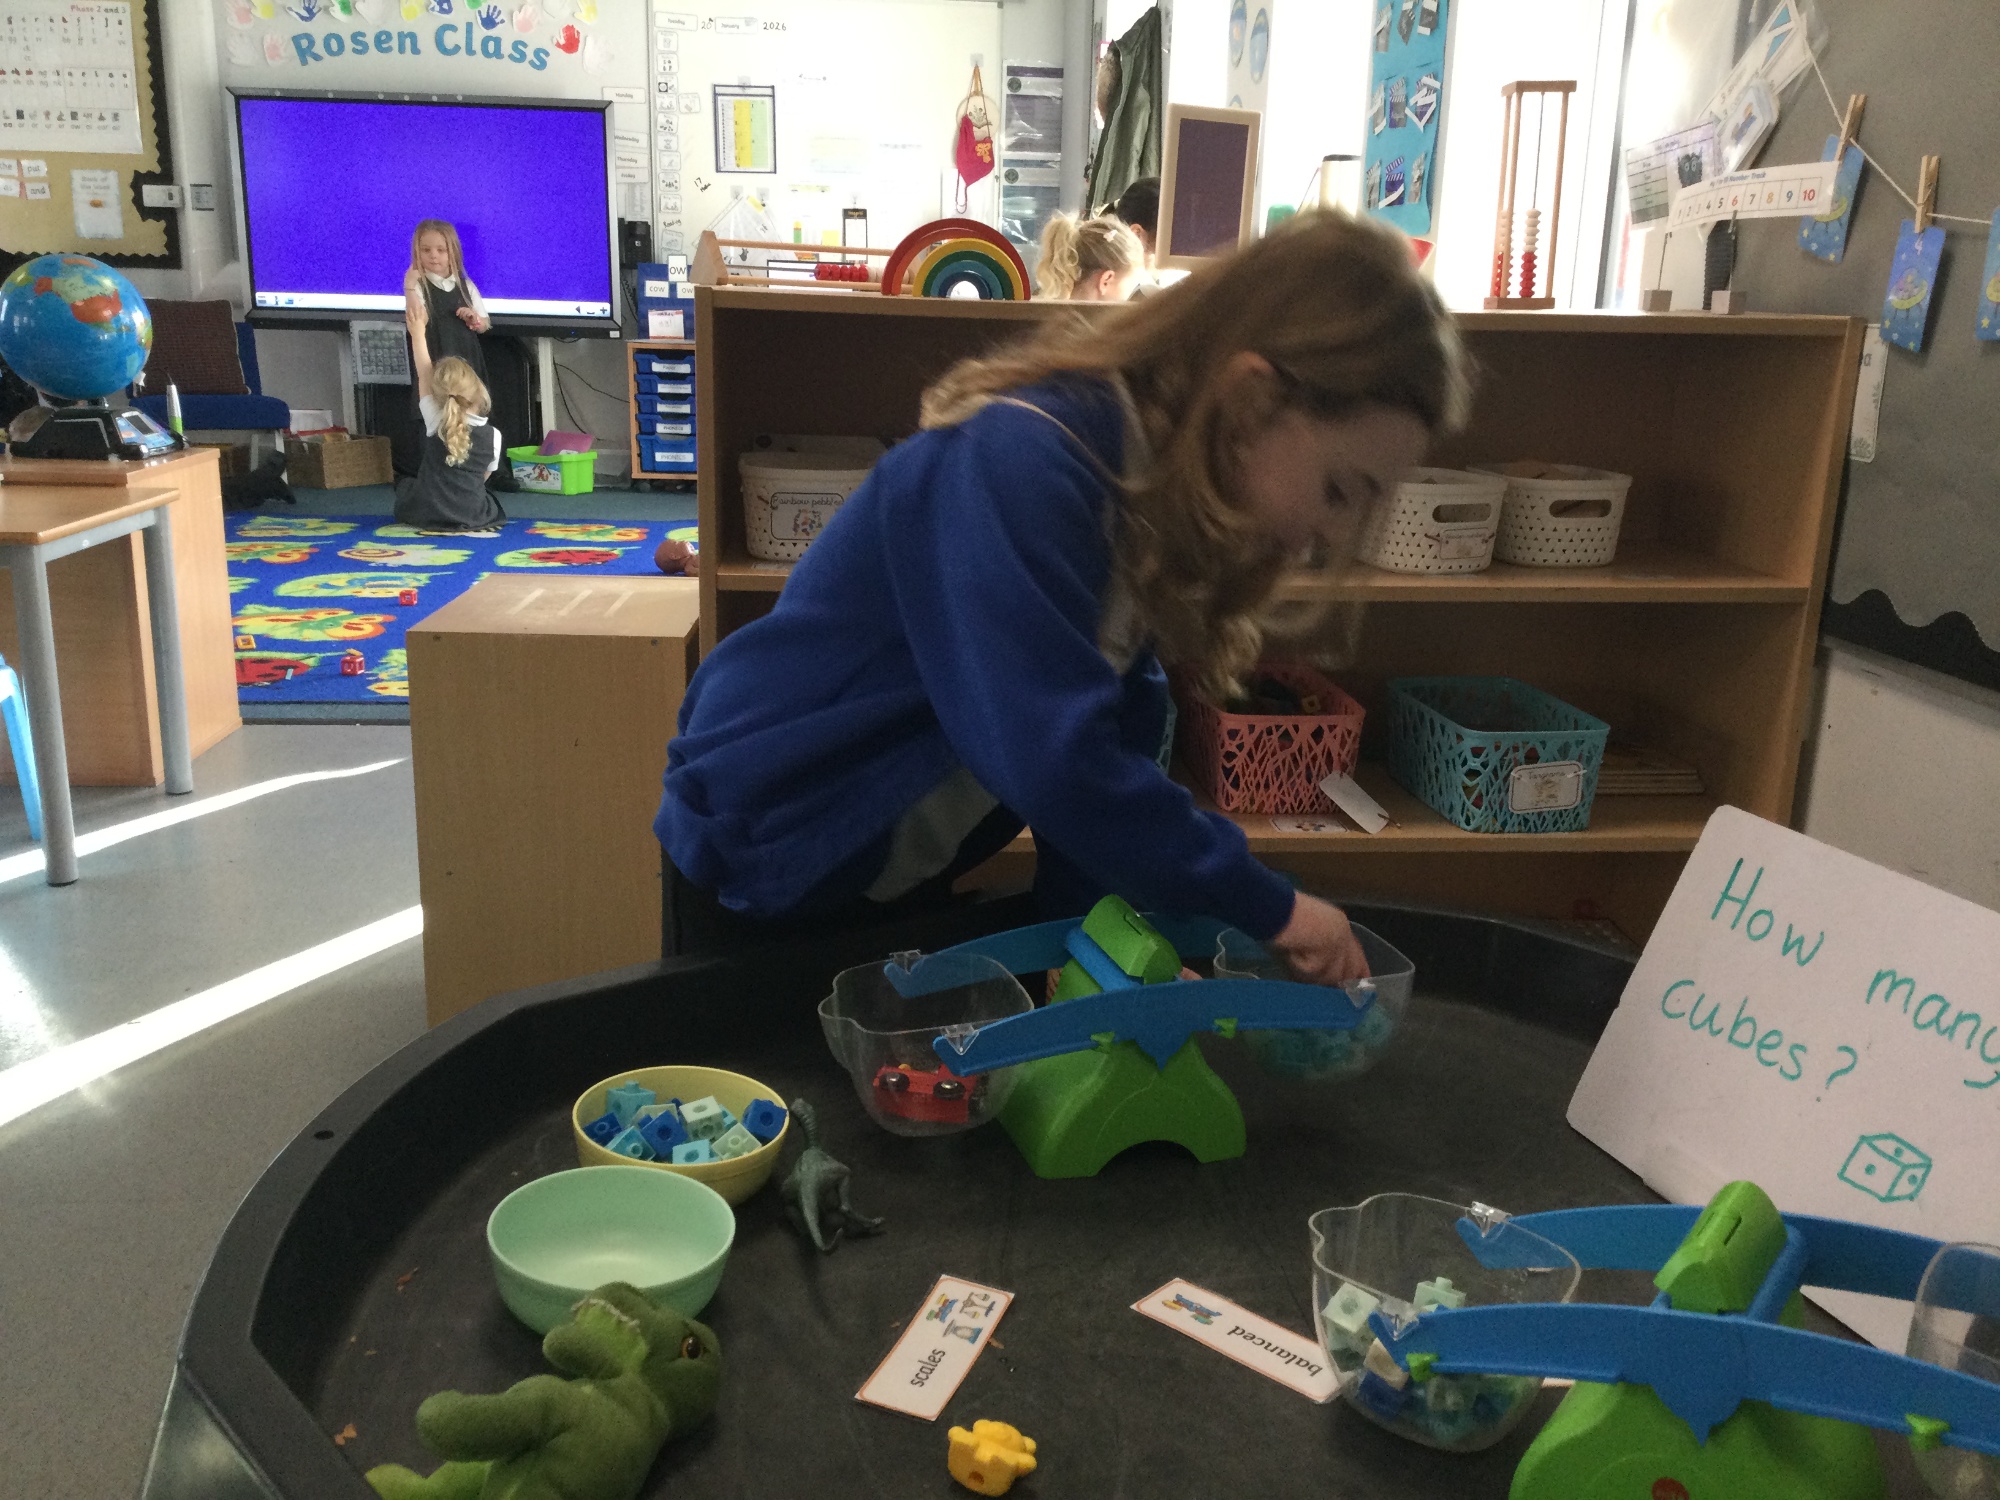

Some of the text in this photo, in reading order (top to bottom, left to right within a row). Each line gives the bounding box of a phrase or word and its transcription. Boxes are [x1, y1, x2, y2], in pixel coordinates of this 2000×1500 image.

[762, 21, 787, 31] 2026
[291, 21, 551, 71] Rosen Class
[615, 91, 634, 99] Monday
[30, 186, 46, 195] and
[1705, 200, 1711, 210] 4
[1717, 197, 1724, 208] 5
[1731, 193, 1738, 206] 6
[1749, 193, 1756, 205] 7
[1766, 191, 1774, 204] 8
[1786, 190, 1793, 202] 9
[1802, 188, 1816, 202] 10
[1710, 857, 2000, 1089] How many
[1226, 1325, 1324, 1377] balanced
[910, 1349, 946, 1388] scales
